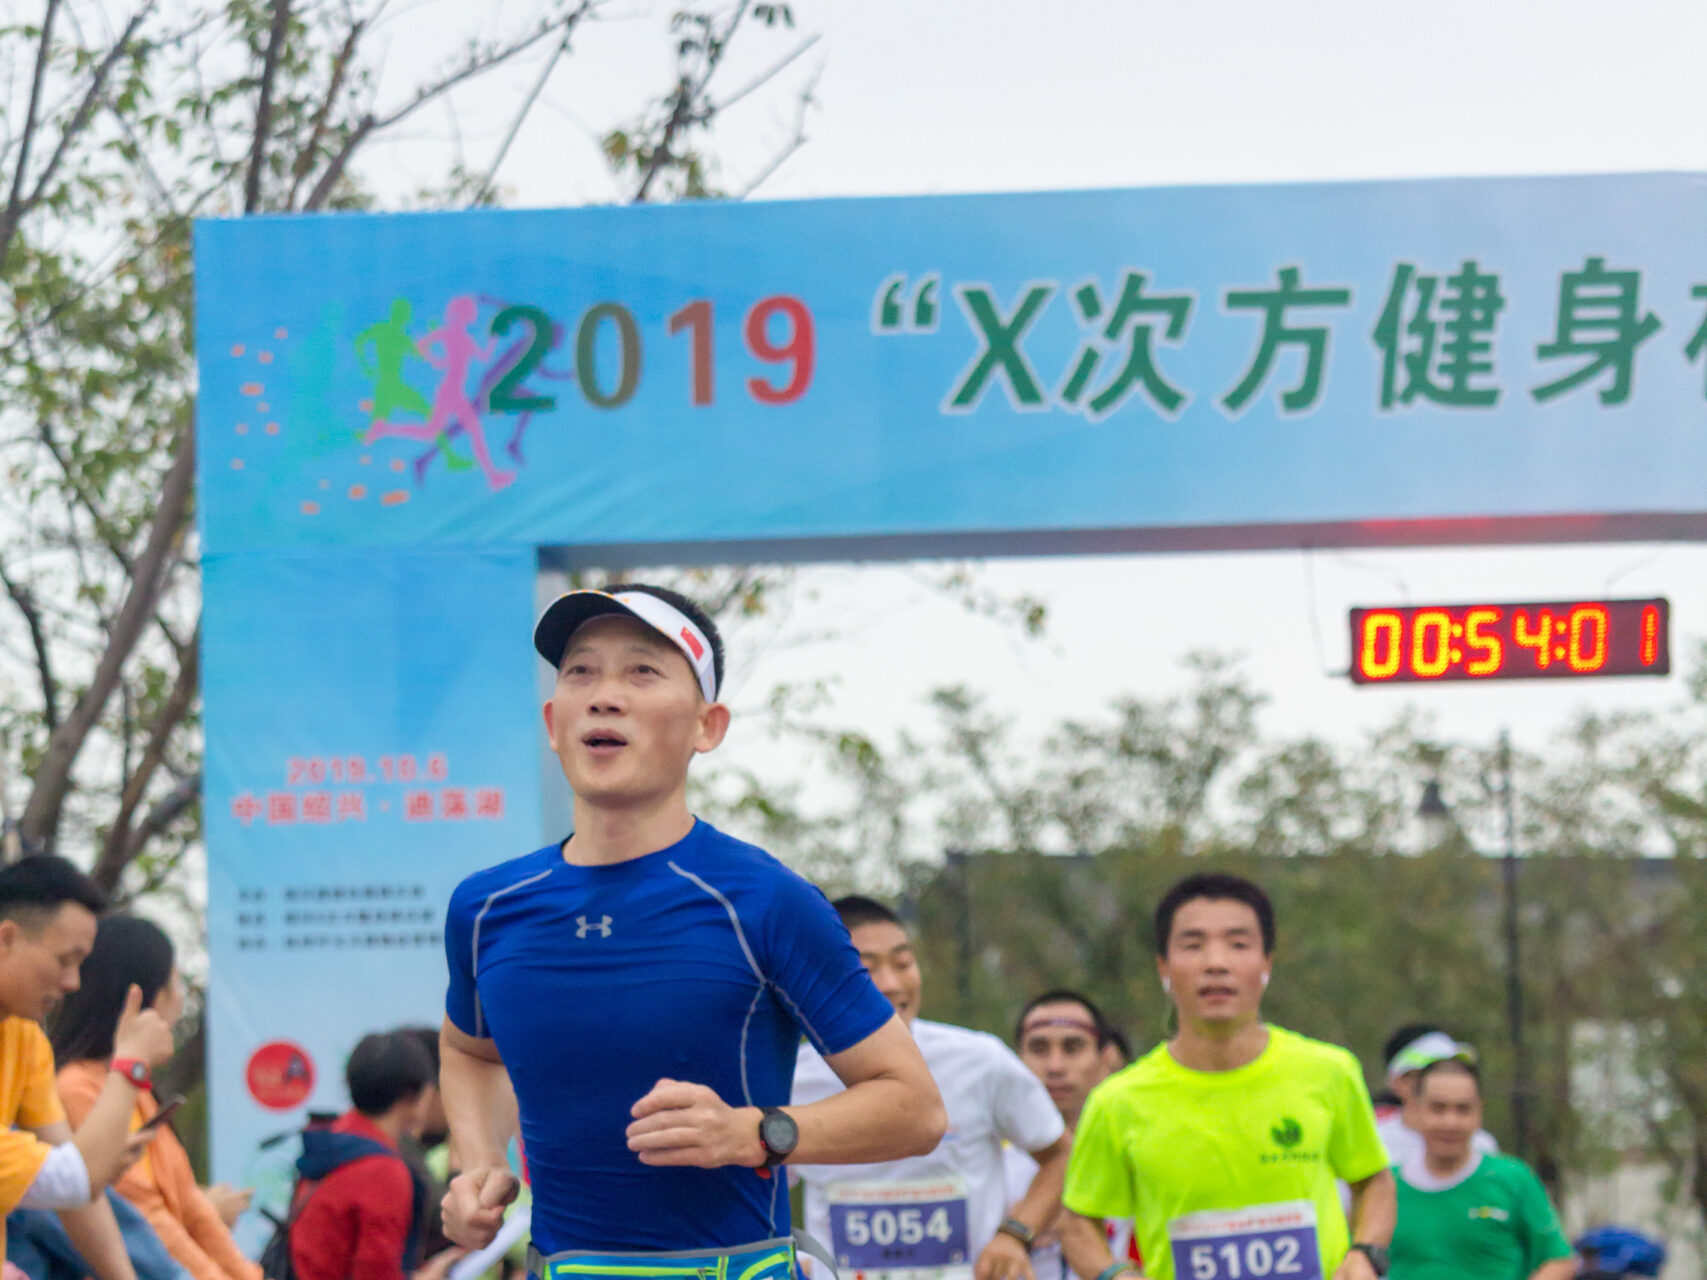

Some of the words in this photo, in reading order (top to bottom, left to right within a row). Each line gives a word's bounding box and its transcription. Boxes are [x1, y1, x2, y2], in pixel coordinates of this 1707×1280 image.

[488, 295, 816, 413] 2019
[875, 256, 1707, 416] “X次方健身
[845, 1206, 953, 1246] 5054
